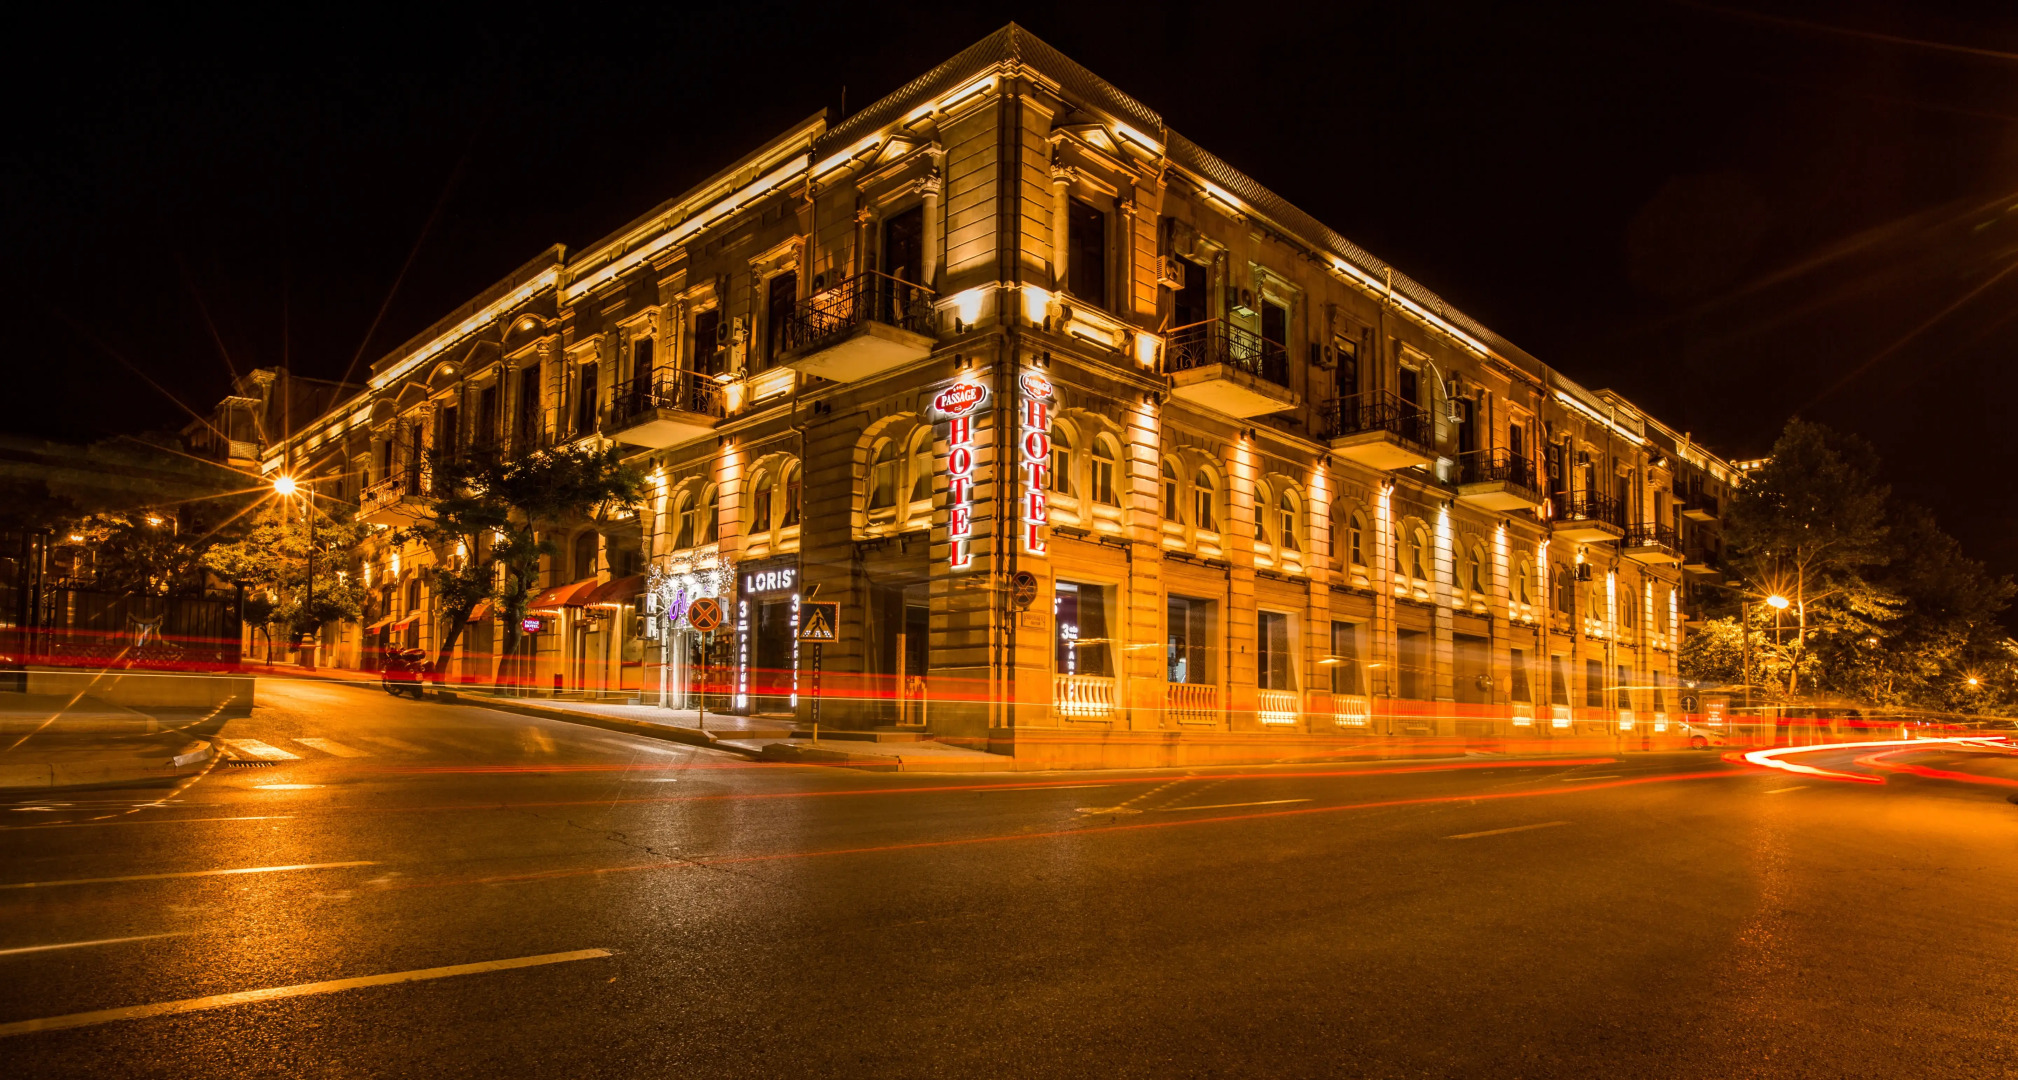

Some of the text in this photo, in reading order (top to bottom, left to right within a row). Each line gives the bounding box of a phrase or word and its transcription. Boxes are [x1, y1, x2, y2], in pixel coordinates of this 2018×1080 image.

[941, 388, 977, 407] PASSAGE
[949, 415, 972, 567] HOTEL
[1025, 398, 1047, 553] HOTEL
[740, 600, 747, 618] 3
